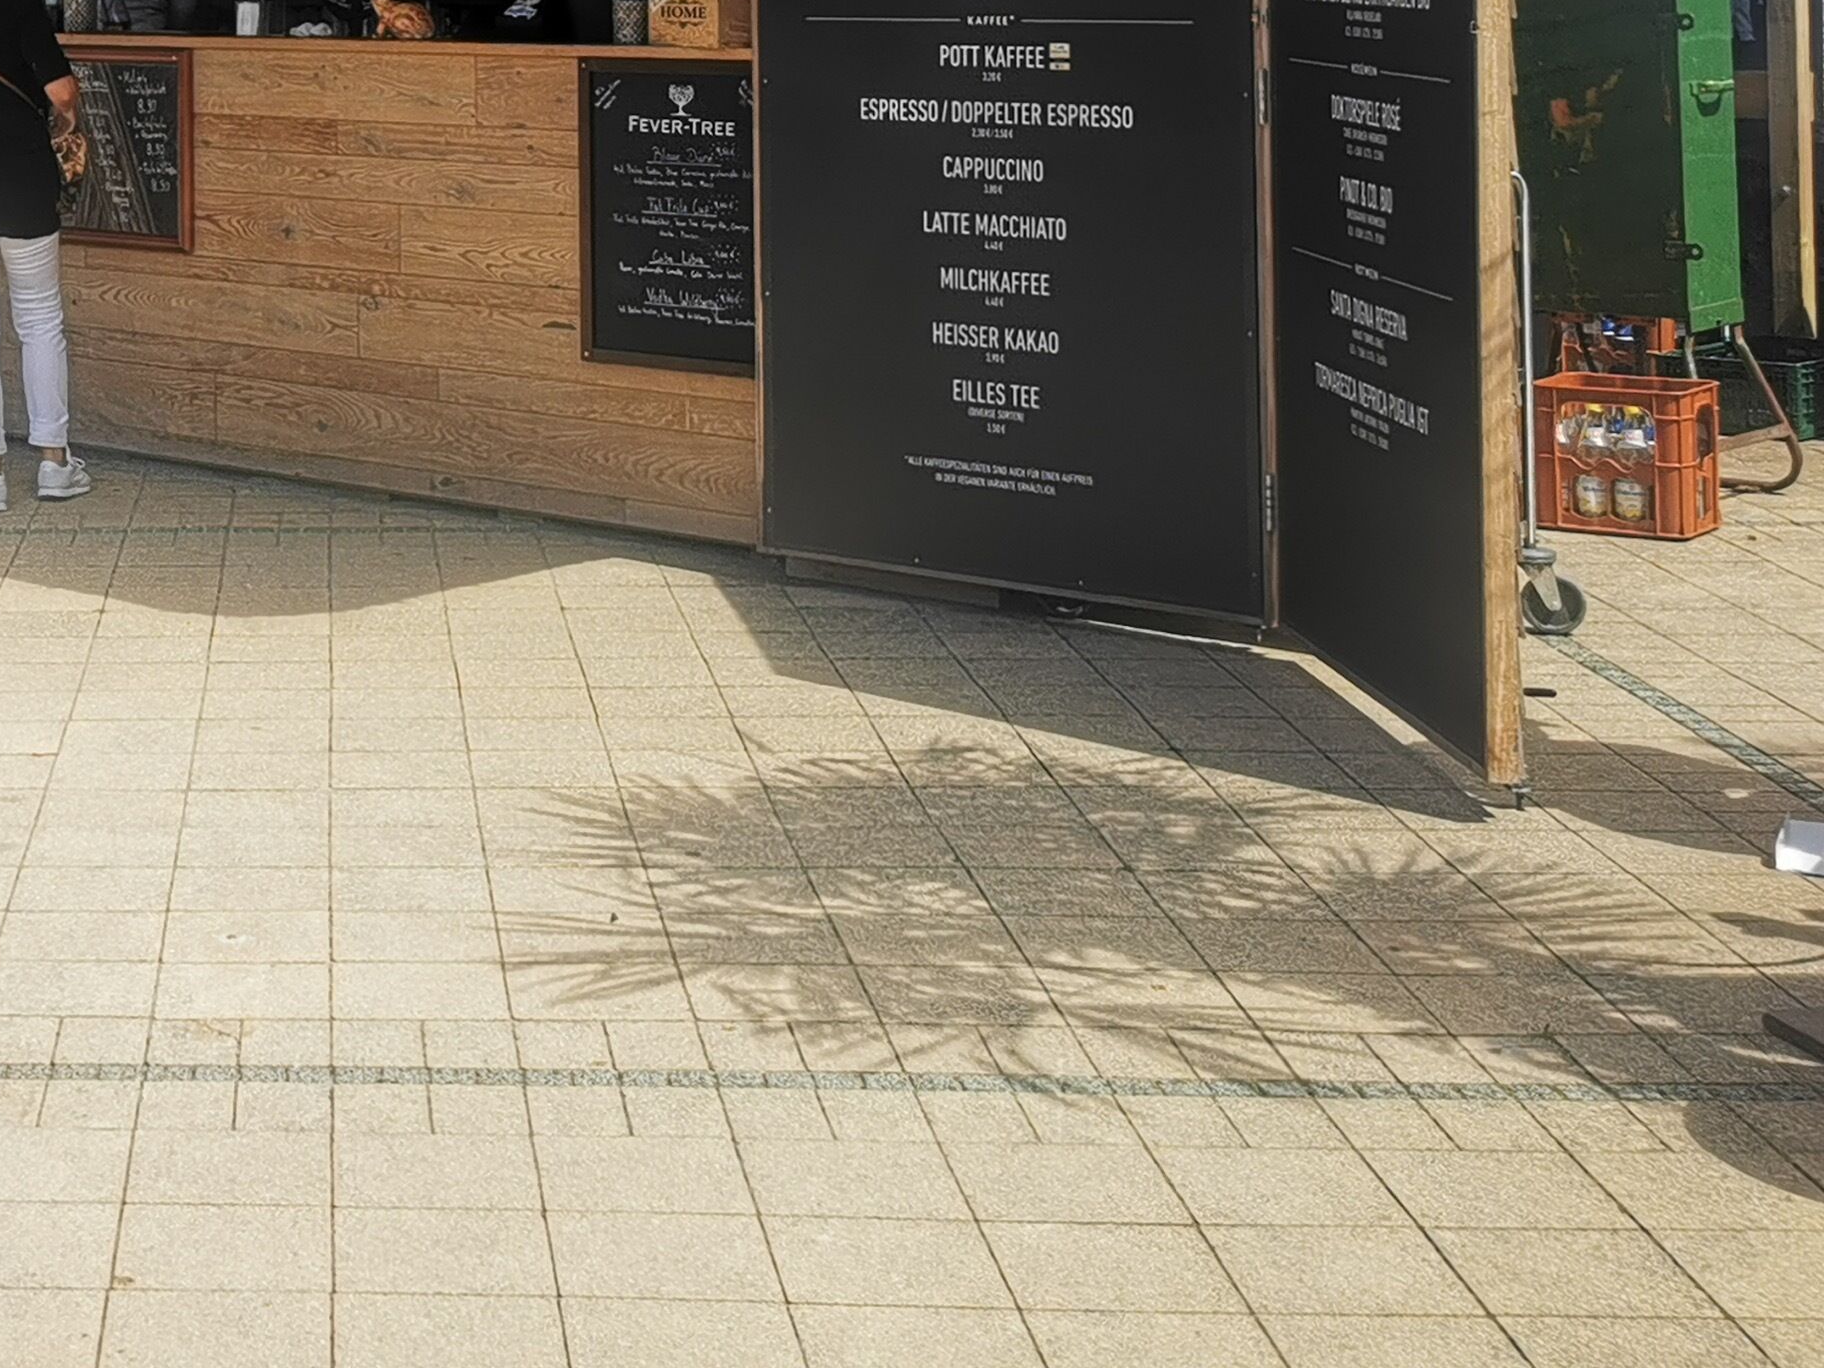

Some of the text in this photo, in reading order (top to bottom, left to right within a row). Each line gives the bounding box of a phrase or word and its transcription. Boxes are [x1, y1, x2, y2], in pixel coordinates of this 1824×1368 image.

[660, 5, 707, 19] HOME
[939, 45, 1045, 70] POTT KAFFEE
[627, 116, 736, 137] FEVER-TREE
[860, 98, 1134, 129] ESPRESSO / DOPPELTER ESPRESSO
[943, 155, 1044, 182] CAPPUCCINO
[923, 209, 1067, 241] LATTE MACCHIATO
[940, 267, 1051, 296] MILCHKAFFEE
[932, 321, 1060, 354] HEISSER KAKAO
[953, 379, 1041, 409] EILLES TEE
